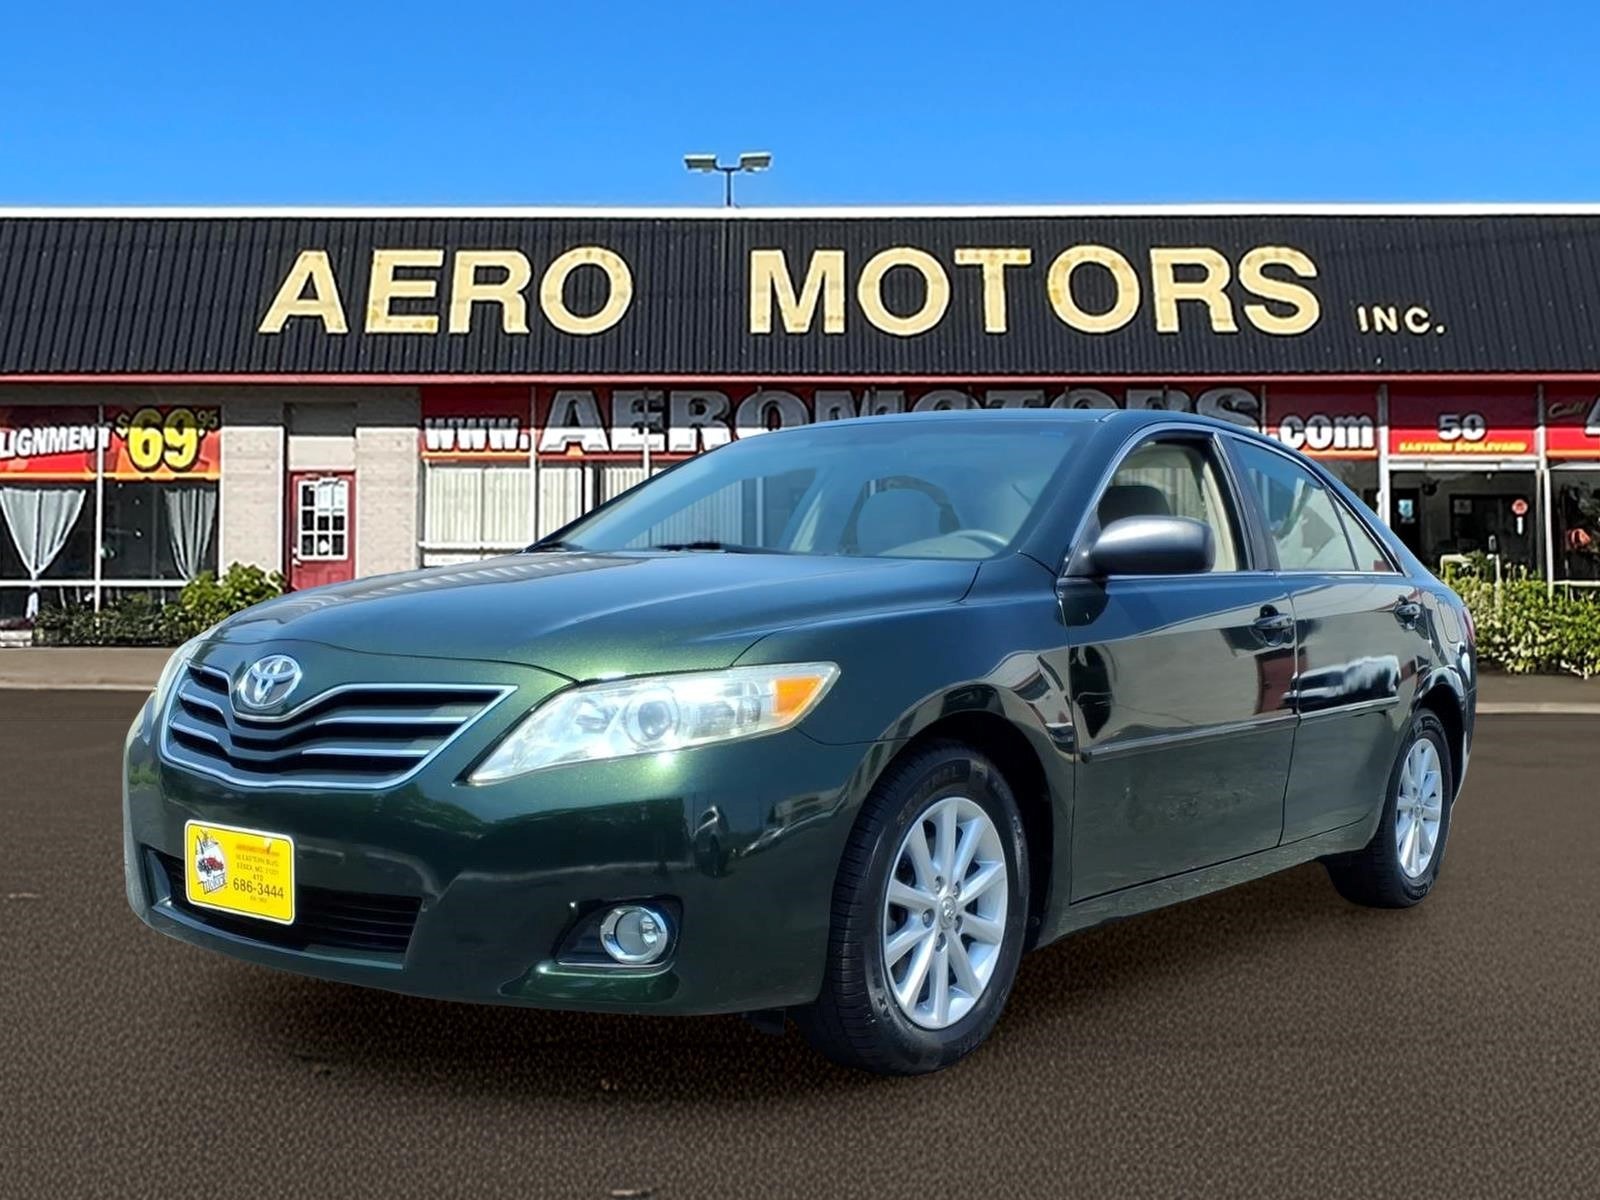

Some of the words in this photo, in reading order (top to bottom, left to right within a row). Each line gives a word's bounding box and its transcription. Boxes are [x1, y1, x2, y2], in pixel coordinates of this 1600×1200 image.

[258, 246, 633, 336] AERO
[749, 245, 1321, 336] MOTORS
[1357, 304, 1446, 335] INC.
[538, 389, 1262, 452] AEROS
[1438, 413, 1486, 441] 50
[233, 877, 284, 899] 686-3444
